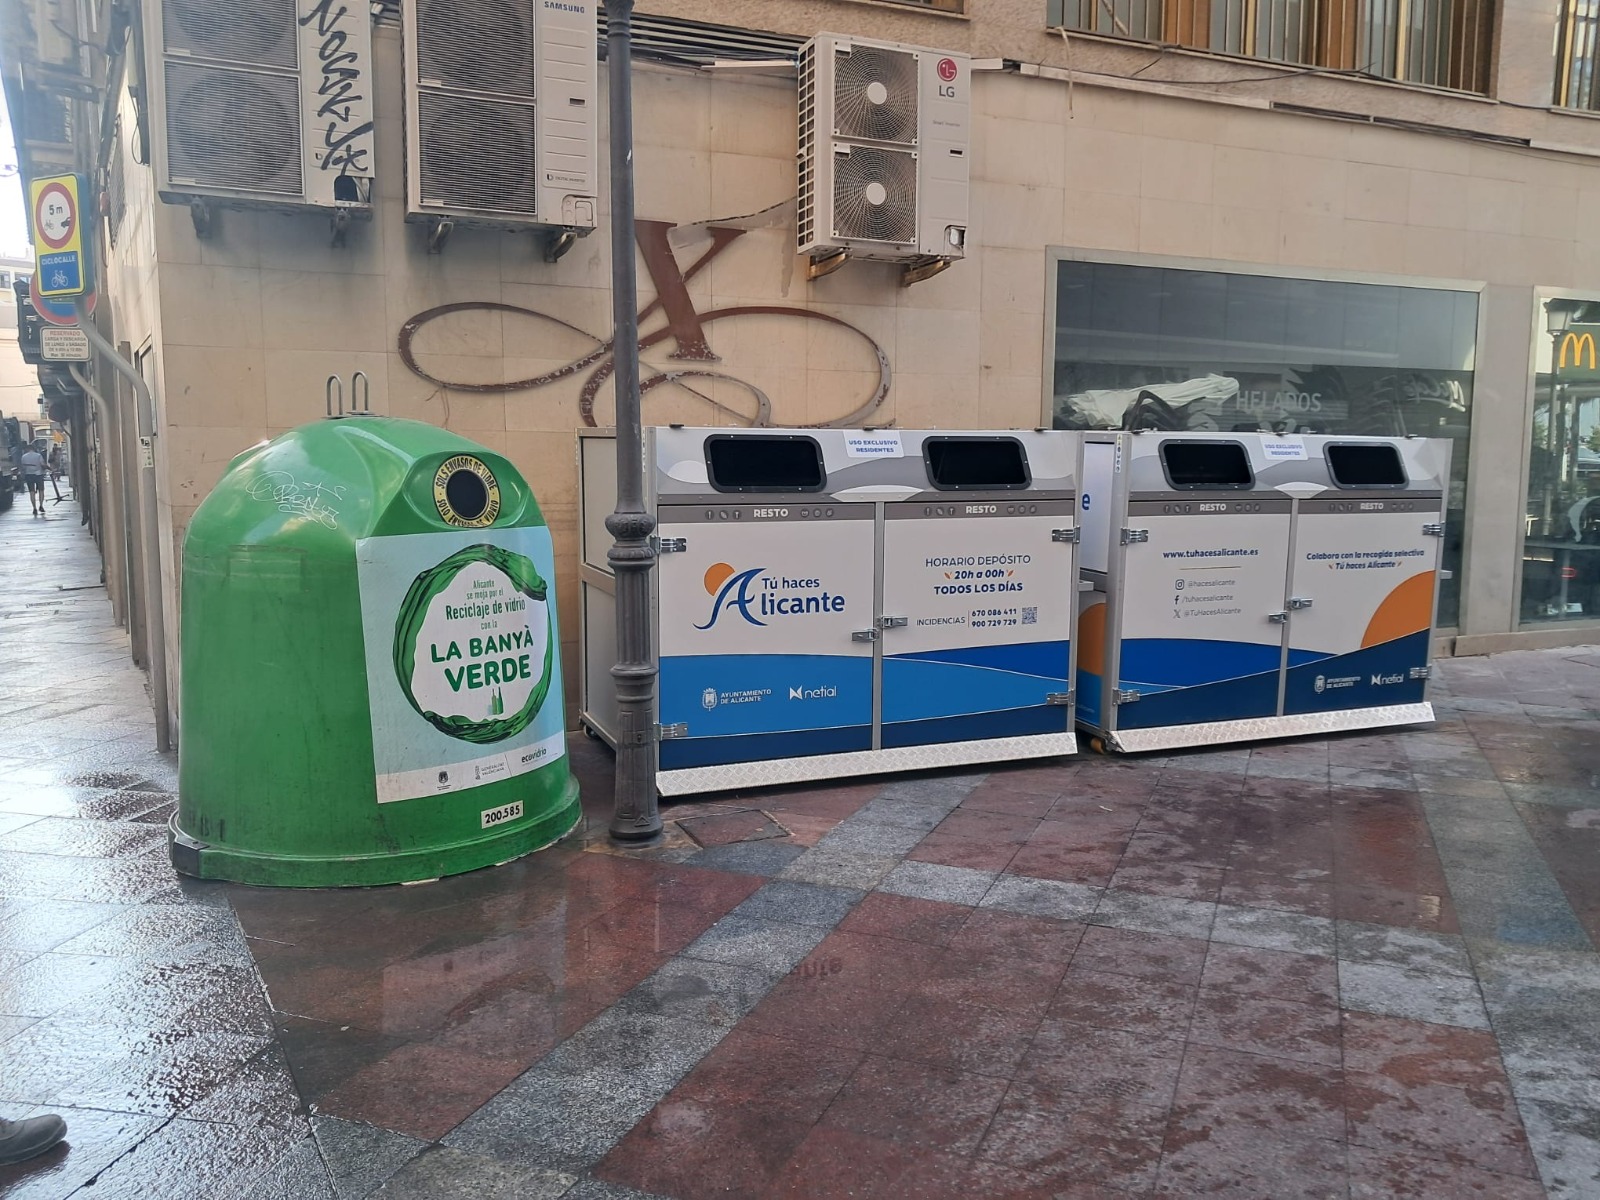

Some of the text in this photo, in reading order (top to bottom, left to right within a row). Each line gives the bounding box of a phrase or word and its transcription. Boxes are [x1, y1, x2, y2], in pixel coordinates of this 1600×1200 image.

[544, 1, 585, 14] SAMSUNG
[938, 85, 955, 98] LG
[49, 205, 63, 215] 5 m
[41, 255, 76, 266] CICLOCALLE
[1235, 390, 1323, 412] HELADOS
[436, 457, 497, 491] SOLS ENVASOS DE VIDRE
[436, 498, 451, 516] SOLO
[484, 499, 499, 523] VIDRIO
[965, 505, 997, 514] RESTO
[1200, 503, 1227, 512] RESTO
[1360, 502, 1384, 510] RESTO
[753, 508, 789, 518] RESTO
[1162, 548, 1259, 558] www.tuhacesalicante.es
[1306, 552, 1340, 560] Colabora
[1354, 551, 1362, 559] la
[1362, 550, 1393, 560] recogida
[1394, 548, 1425, 557] selectiva
[925, 553, 1031, 568] HORARIO DEPÓSITO
[1335, 560, 1396, 570] Tú haces Alicante
[954, 569, 1005, 580] 20h a 00h
[472, 578, 495, 590] Alicante
[761, 576, 820, 590] Tú haces
[934, 580, 1023, 595] TODOS LOS DÍAS
[466, 588, 504, 600] se moja por el
[446, 598, 526, 620] Reciclaje de vidrio
[916, 616, 966, 626] INCIDENCIAS
[971, 609, 986, 617] 670
[987, 608, 1002, 616] 086
[971, 620, 986, 628] 900
[1003, 618, 1017, 626] 729
[480, 620, 498, 630] con la
[430, 624, 534, 663] LA BANYÀ
[444, 654, 532, 693] VERDE
[720, 688, 772, 698] AYUNTAMIENTO
[804, 684, 837, 699] netial
[730, 696, 762, 704] ALICANTE
[521, 747, 547, 763] ecovidrio
[484, 804, 520, 824] 200.585
